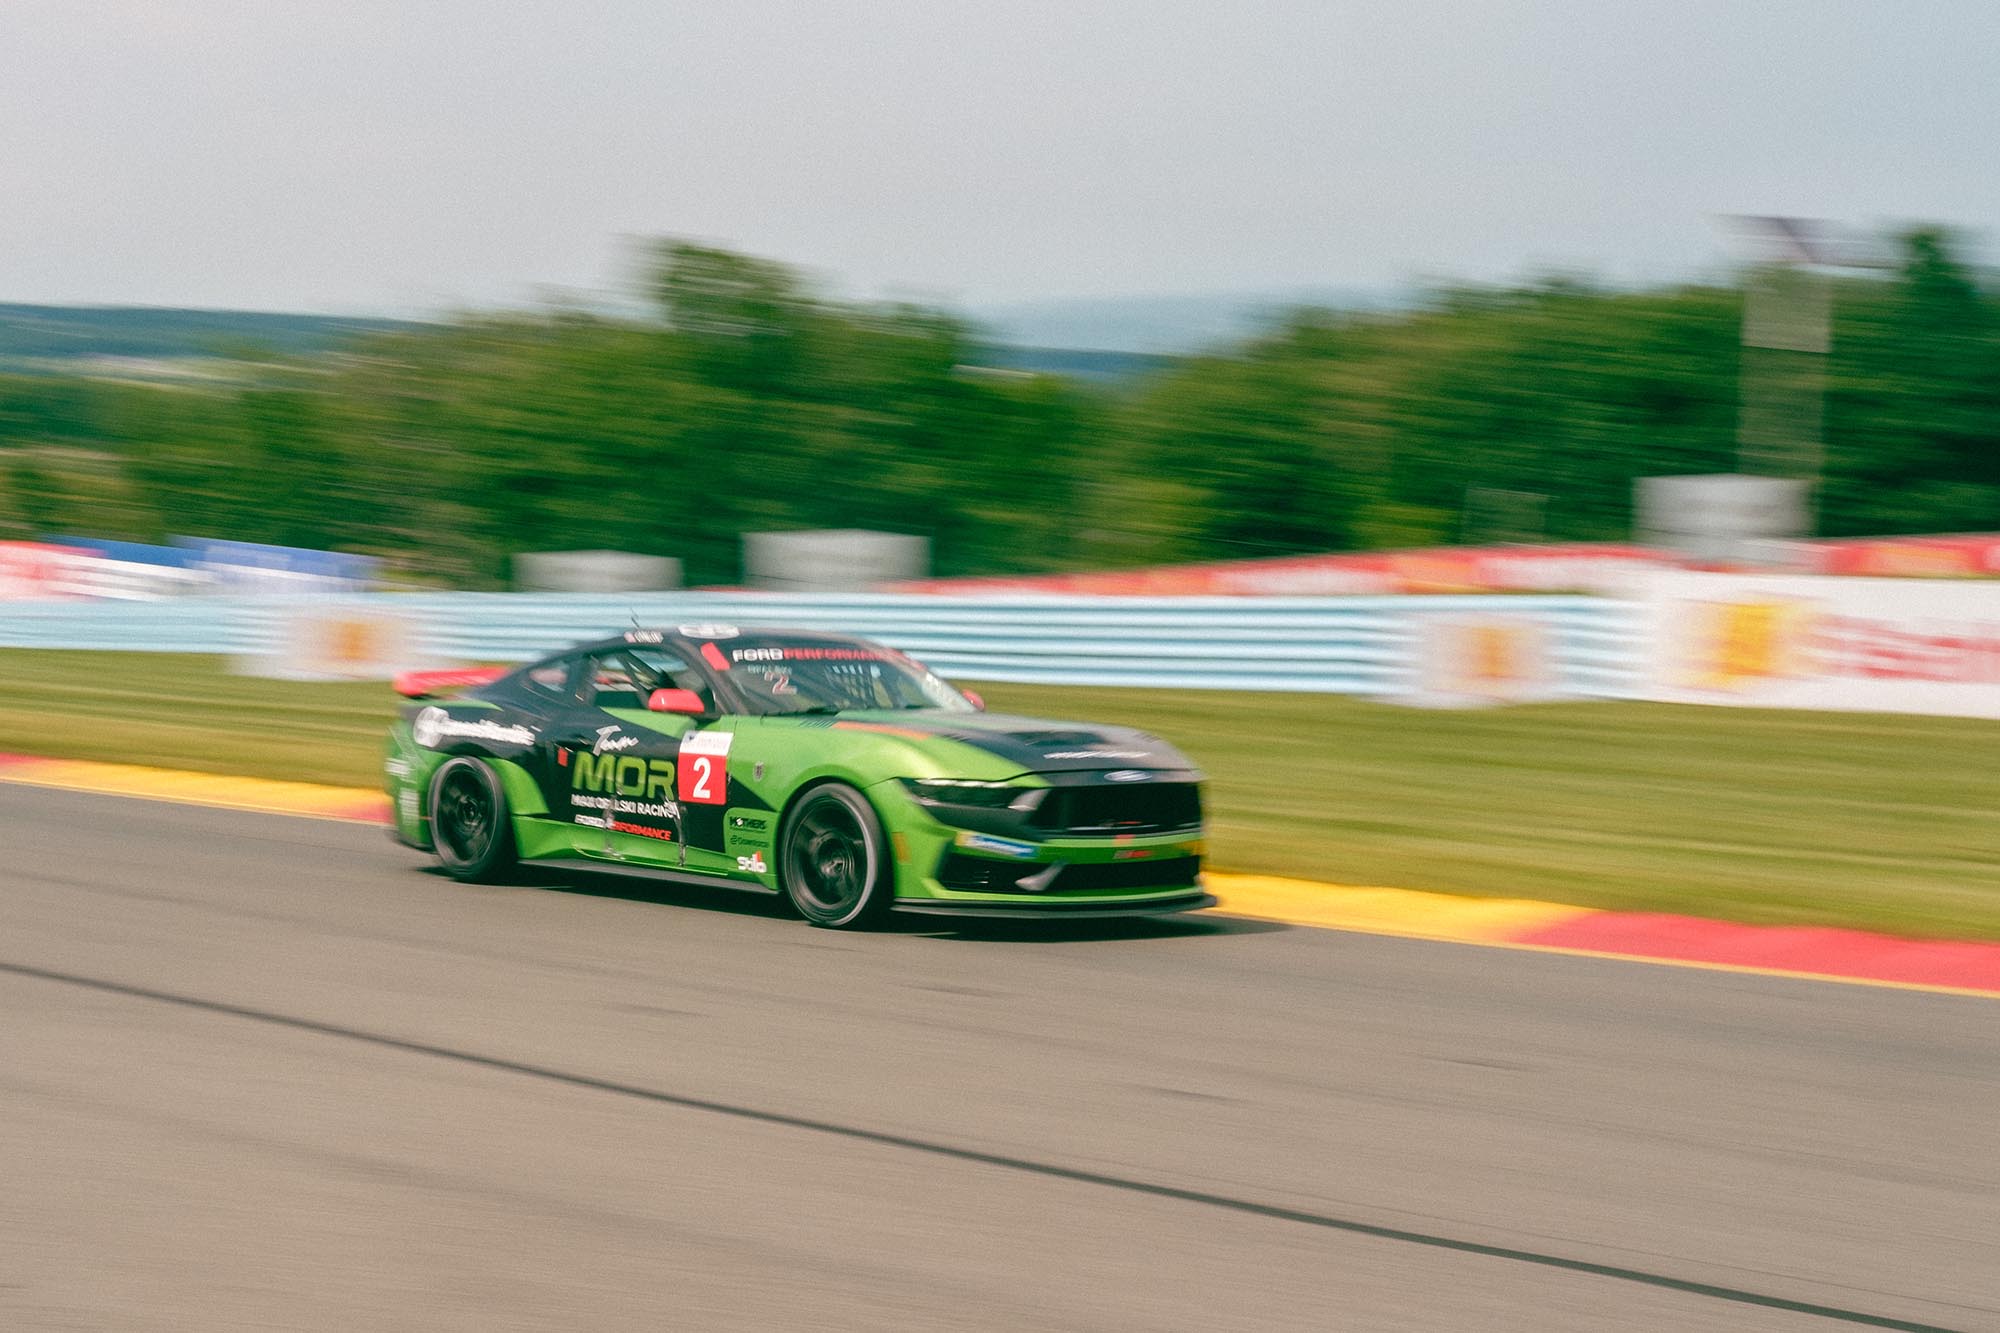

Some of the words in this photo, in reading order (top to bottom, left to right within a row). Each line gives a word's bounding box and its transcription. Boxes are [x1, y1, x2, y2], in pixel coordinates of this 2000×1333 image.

[572, 750, 676, 801] MOR
[692, 756, 712, 799] 2
[595, 797, 637, 814] OPLSKI
